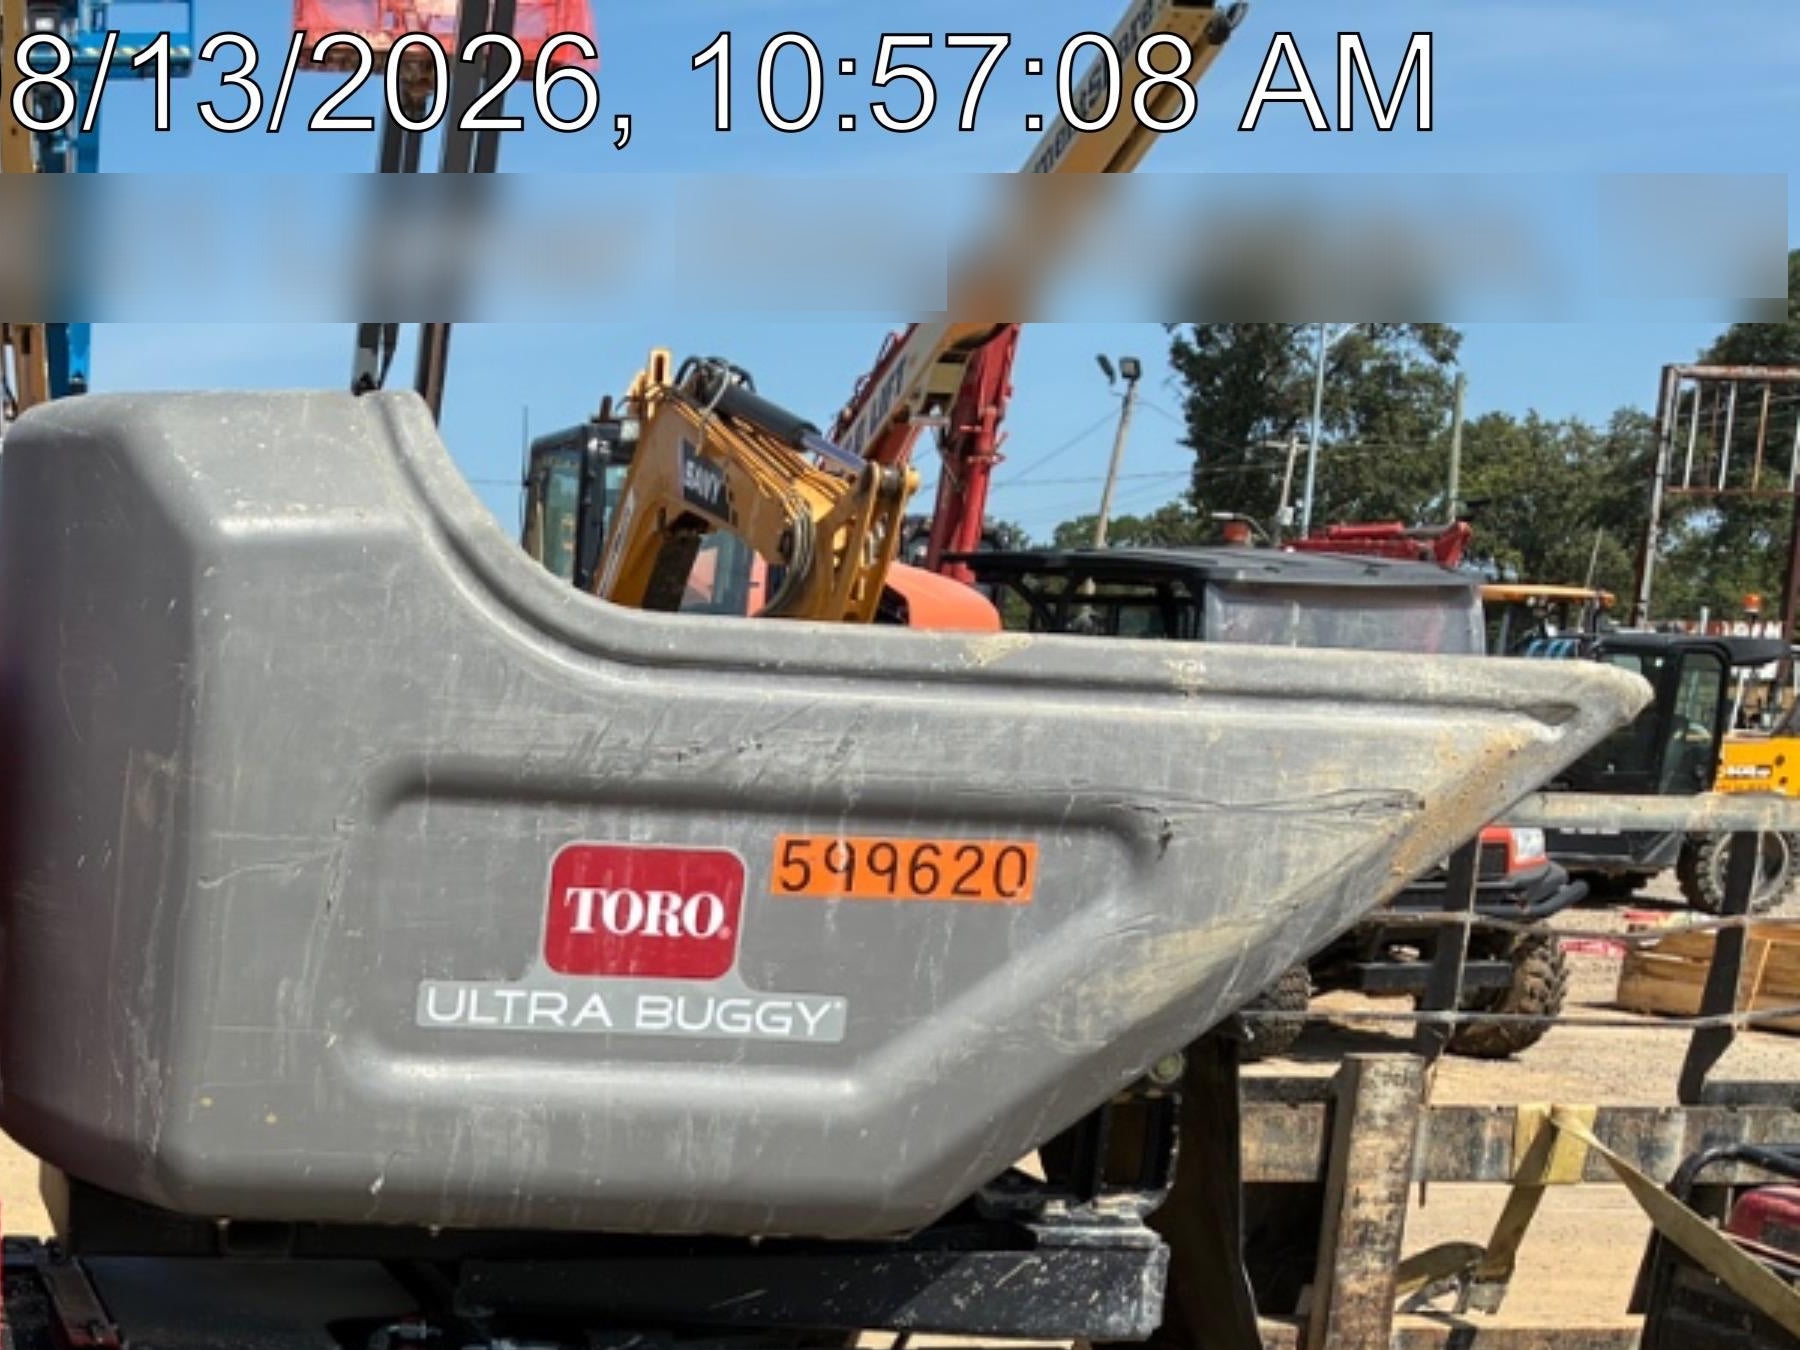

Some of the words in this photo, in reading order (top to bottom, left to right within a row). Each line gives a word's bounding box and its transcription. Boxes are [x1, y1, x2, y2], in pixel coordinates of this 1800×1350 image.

[779, 838, 1029, 899] 599620
[563, 886, 728, 939] TORO
[425, 986, 613, 1028] ULTRA
[635, 993, 834, 1036] BUGGY
